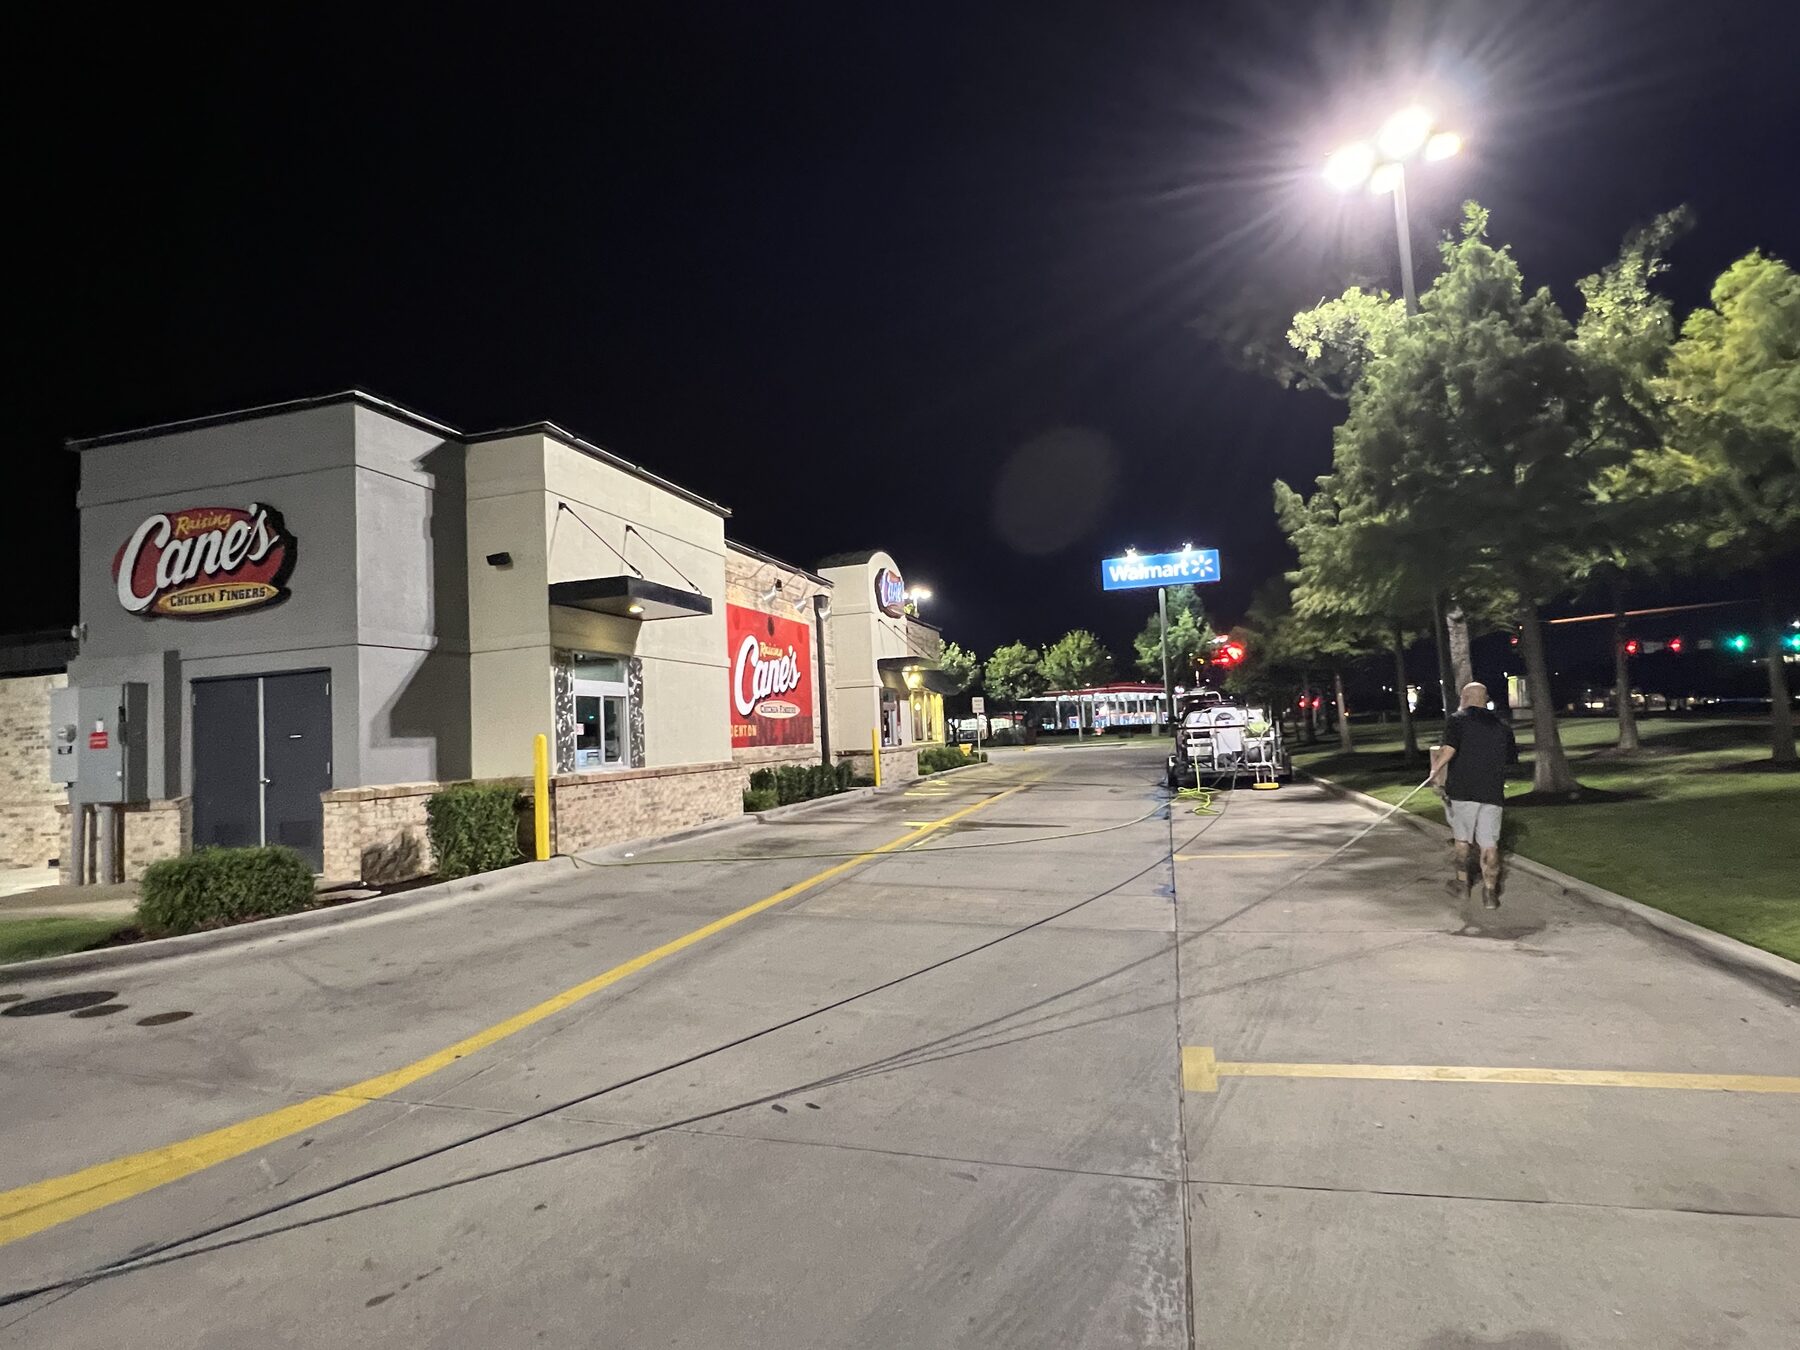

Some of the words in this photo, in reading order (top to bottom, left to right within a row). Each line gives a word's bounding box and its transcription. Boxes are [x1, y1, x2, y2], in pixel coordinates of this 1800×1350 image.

[175, 511, 232, 535] Raising
[118, 503, 280, 612] Cane's
[1108, 559, 1189, 582] Walmart
[759, 642, 783, 659] Raising
[734, 634, 800, 716] Cane's
